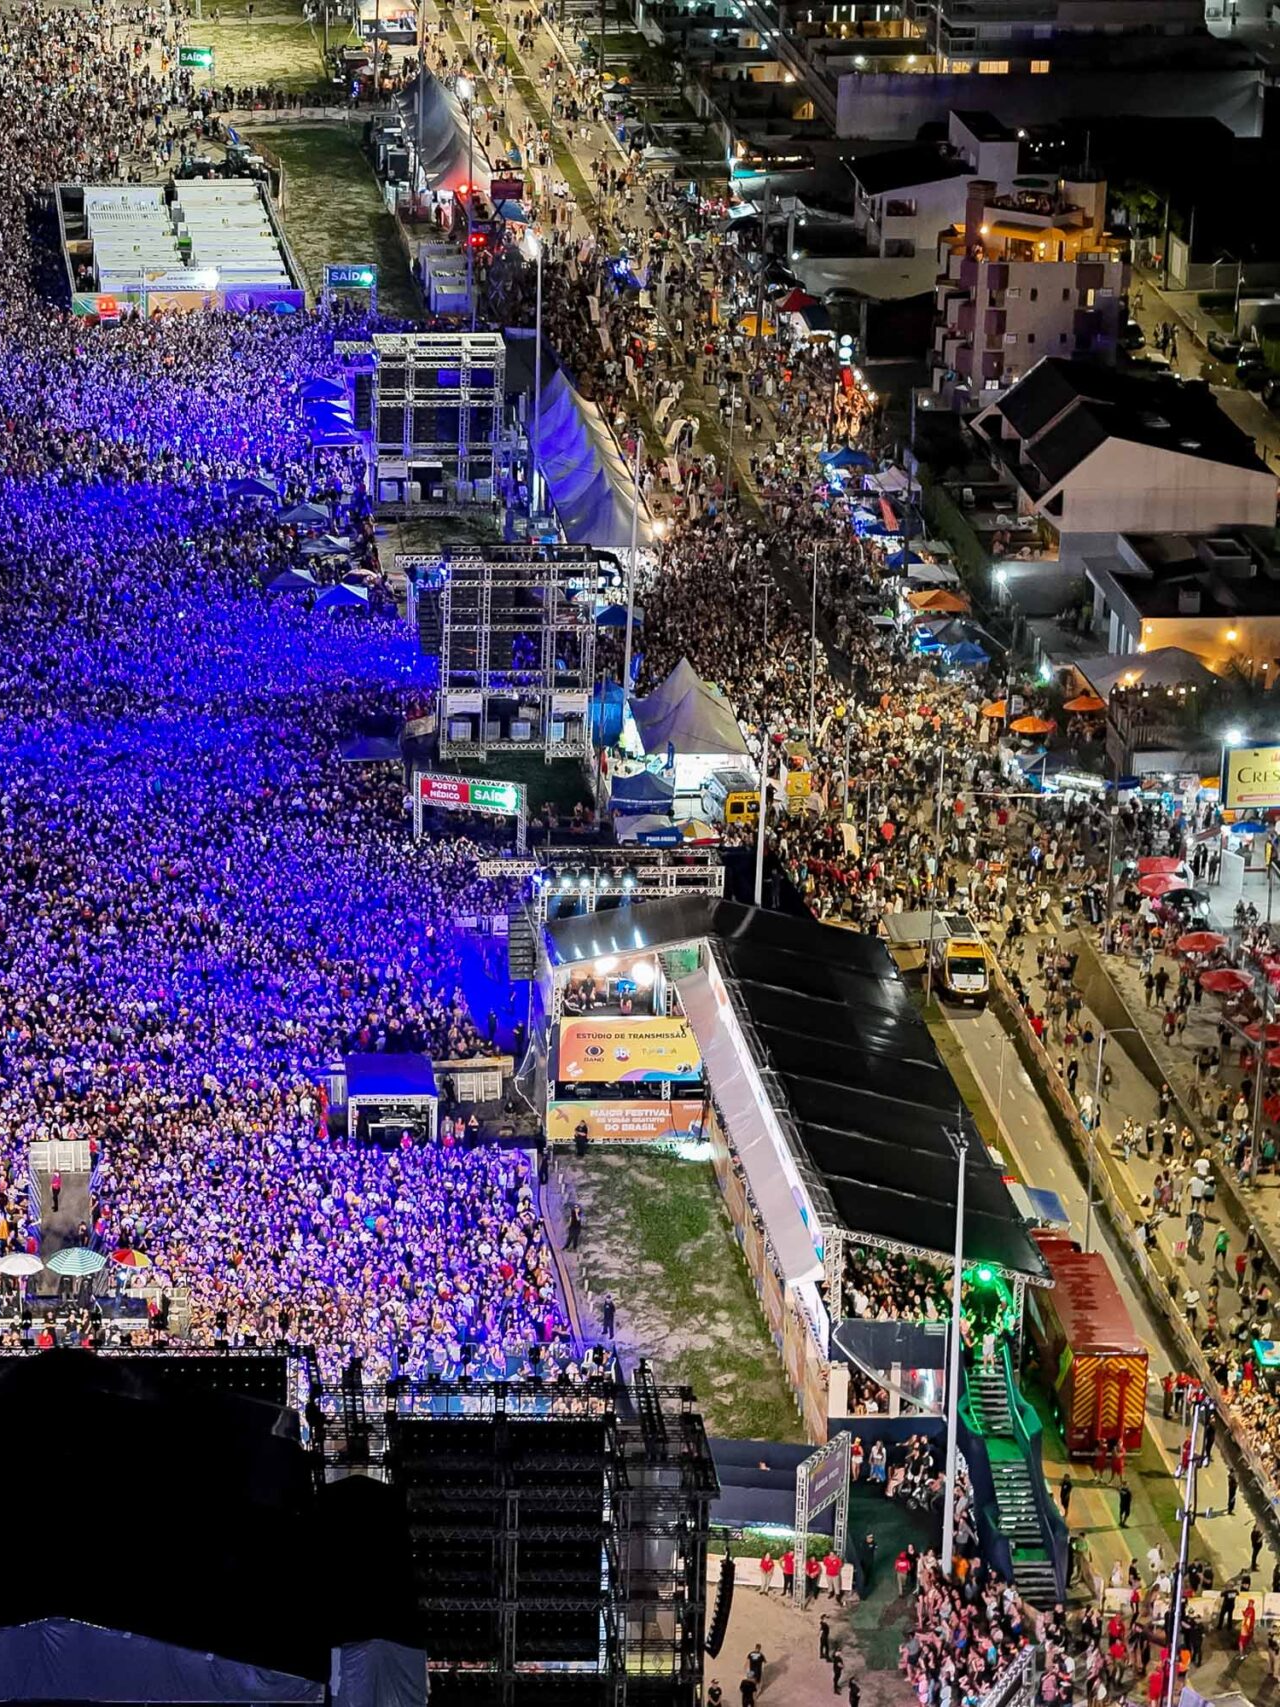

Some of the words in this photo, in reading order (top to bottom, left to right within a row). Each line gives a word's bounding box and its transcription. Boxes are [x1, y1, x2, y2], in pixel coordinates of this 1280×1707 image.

[181, 51, 209, 61] SAÍD
[568, 576, 606, 589] CHOP
[431, 782, 458, 791] POSTO
[430, 789, 460, 800] MÉDICO
[474, 789, 507, 803] SAÍD
[576, 1031, 612, 1040] ESTÚDIO
[614, 1032, 626, 1040] DE
[628, 1031, 687, 1040] TRANSMISSÃO
[624, 1109, 672, 1117] FESTIVAL
[604, 1123, 619, 1131] DO
[621, 1123, 657, 1131] BRASIL
